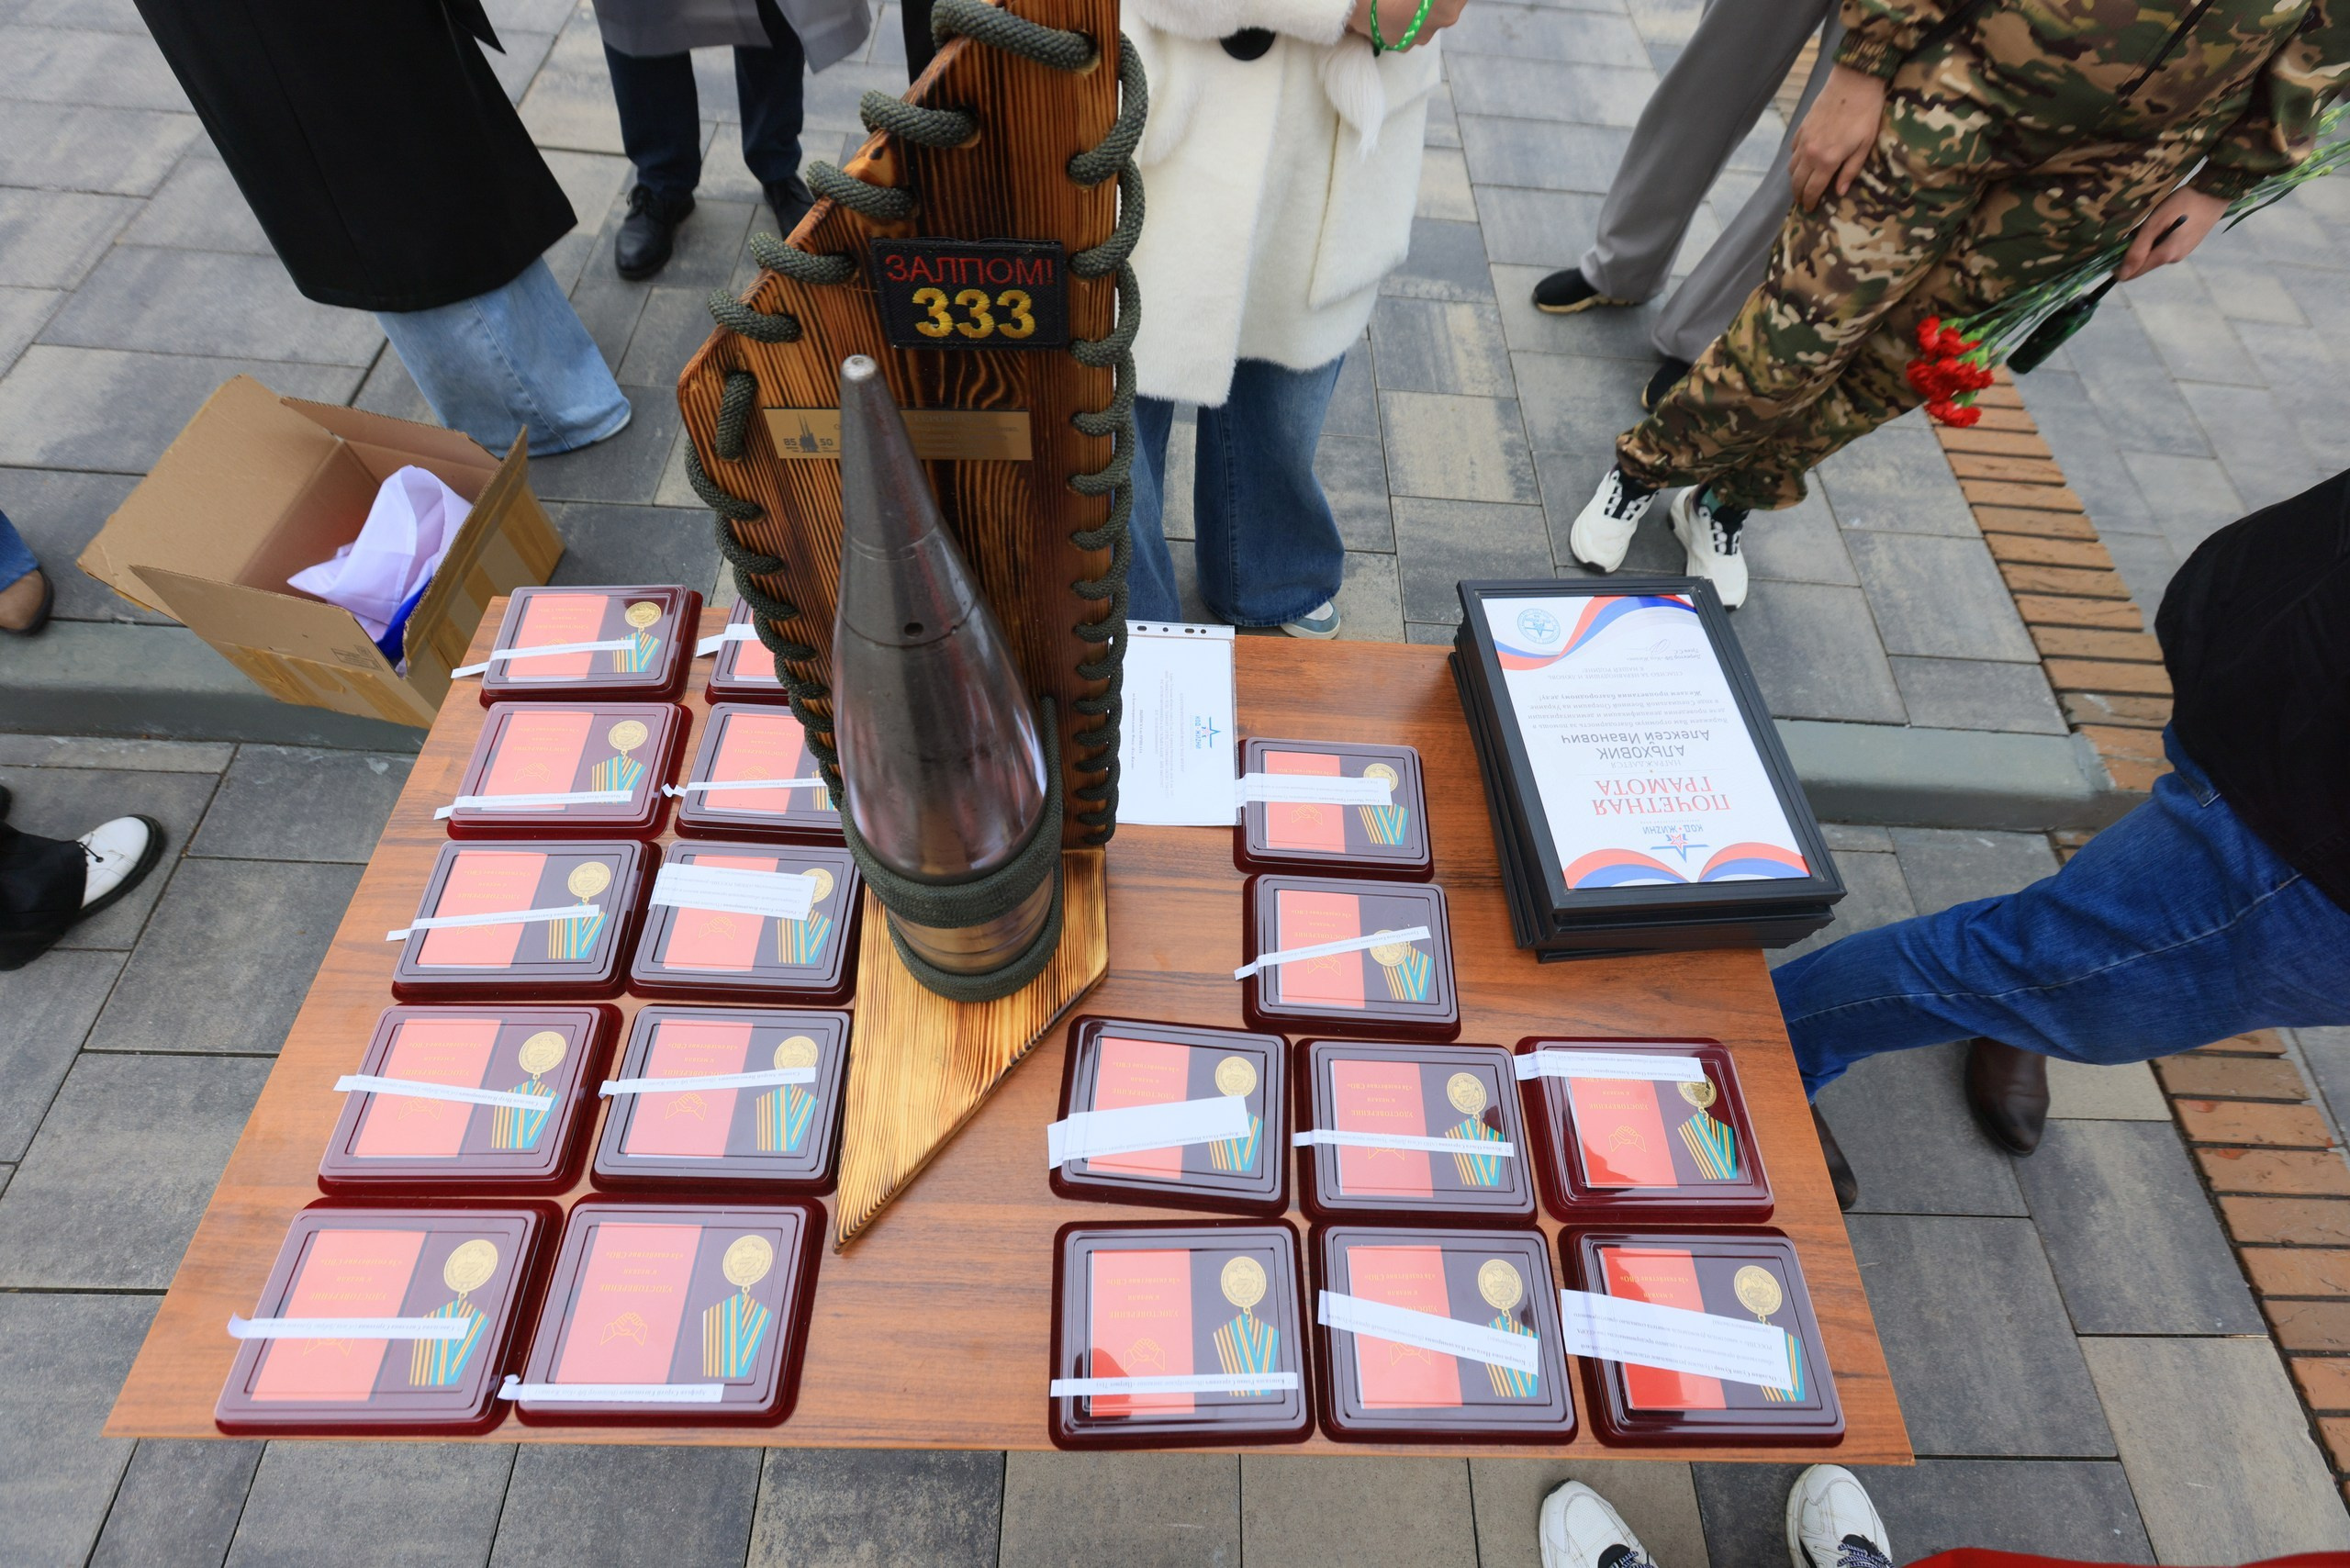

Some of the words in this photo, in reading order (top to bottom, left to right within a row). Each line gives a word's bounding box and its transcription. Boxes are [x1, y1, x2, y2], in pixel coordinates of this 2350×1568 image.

[885, 254, 1055, 285] ЗАЛПОМ!
[912, 287, 1036, 340] 333
[820, 438, 834, 446] 50
[1617, 691, 1669, 700] процветания
[1604, 711, 1662, 719] денацификации
[1561, 733, 1640, 745] Иванович
[1644, 730, 1709, 745] Алексей
[1595, 745, 1684, 759] АЛЬХОВИК
[1610, 759, 1681, 768] НАГРАЖДАЕТСЯ
[1594, 777, 1713, 796] ГРАМОТА
[1591, 794, 1730, 815] ПОЧЕТНАЯ
[1683, 824, 1703, 833] КОД
[1351, 1108, 1413, 1118] УДОСТОВЕРЕНИЕ
[599, 1283, 674, 1294] УДОСТОВЕРЕНИЕ
